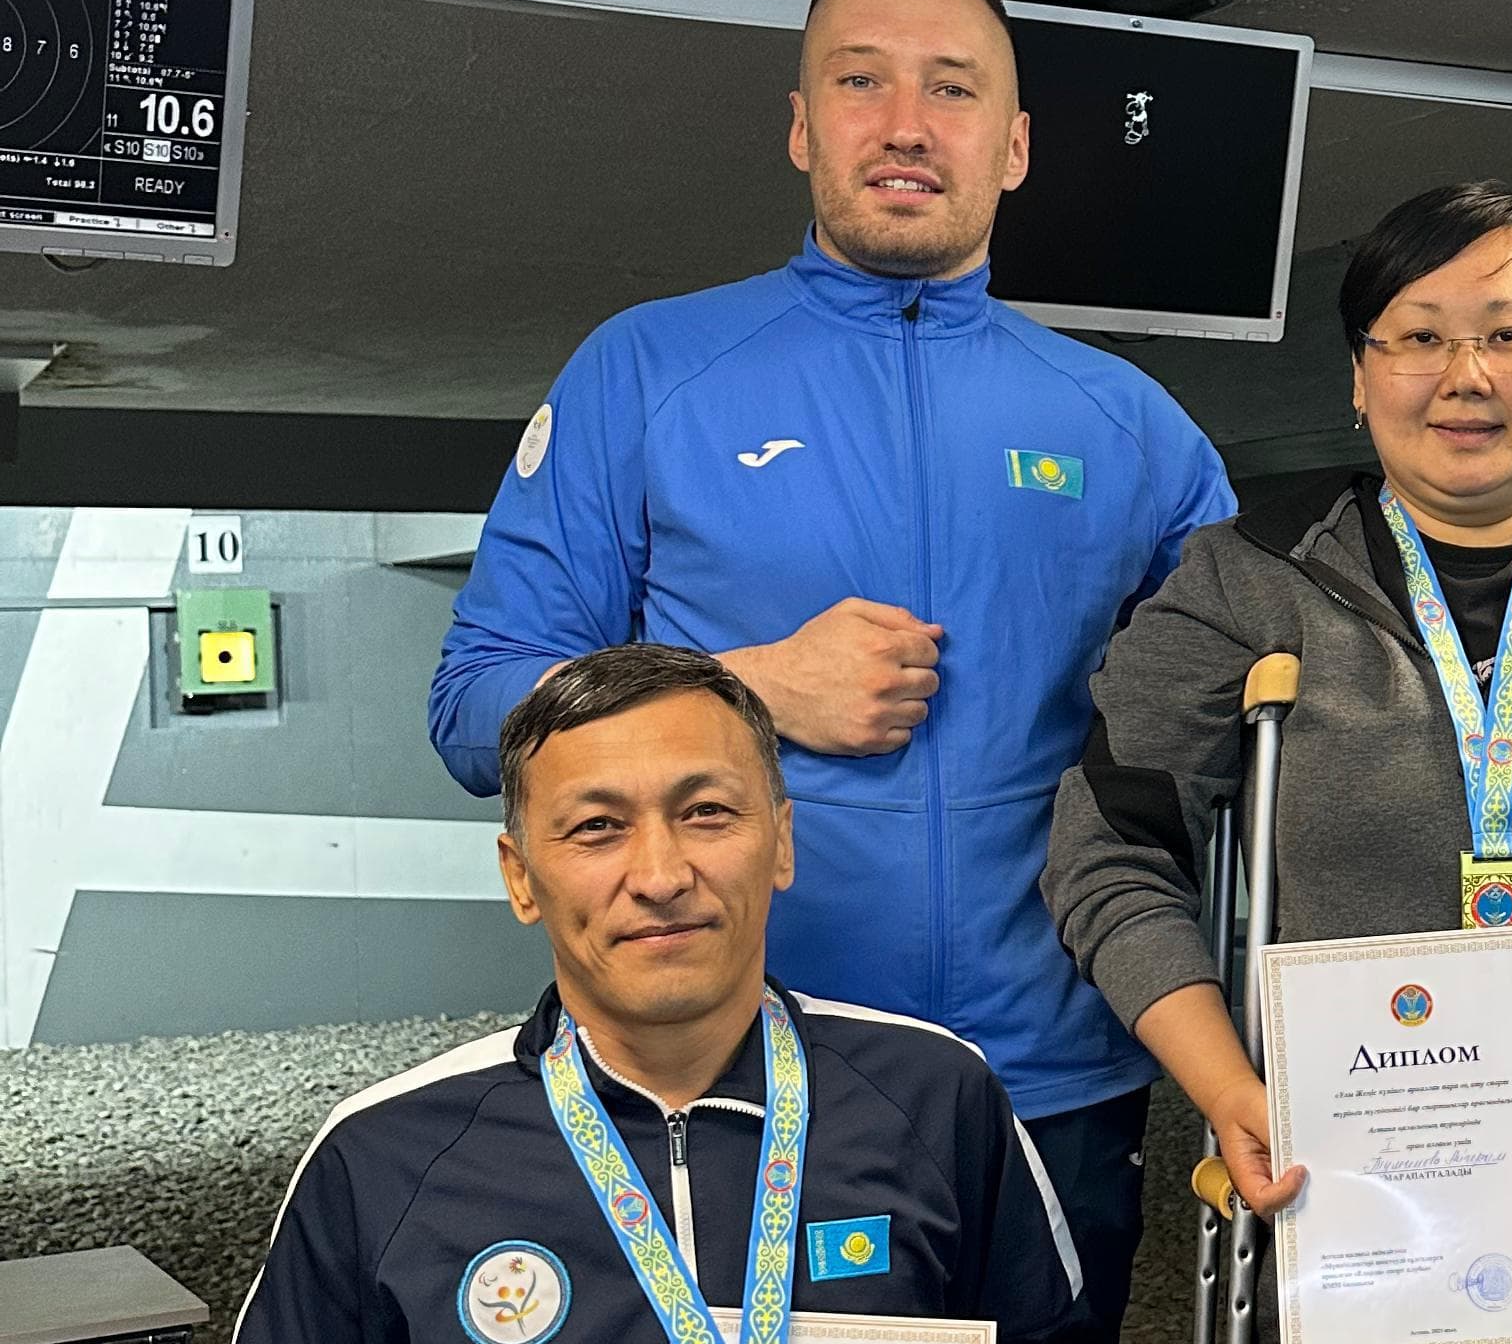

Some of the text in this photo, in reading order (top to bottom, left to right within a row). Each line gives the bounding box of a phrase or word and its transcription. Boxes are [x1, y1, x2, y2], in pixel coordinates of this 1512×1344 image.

[2, 36, 80, 59] 8 7 6
[109, 63, 151, 76] Subtotal
[106, 113, 118, 128] 11
[140, 93, 215, 138] 10.6
[114, 139, 140, 156] S10
[144, 142, 169, 158] S10
[134, 176, 186, 195] READY
[69, 215, 110, 225] Practice
[195, 530, 240, 562] 10
